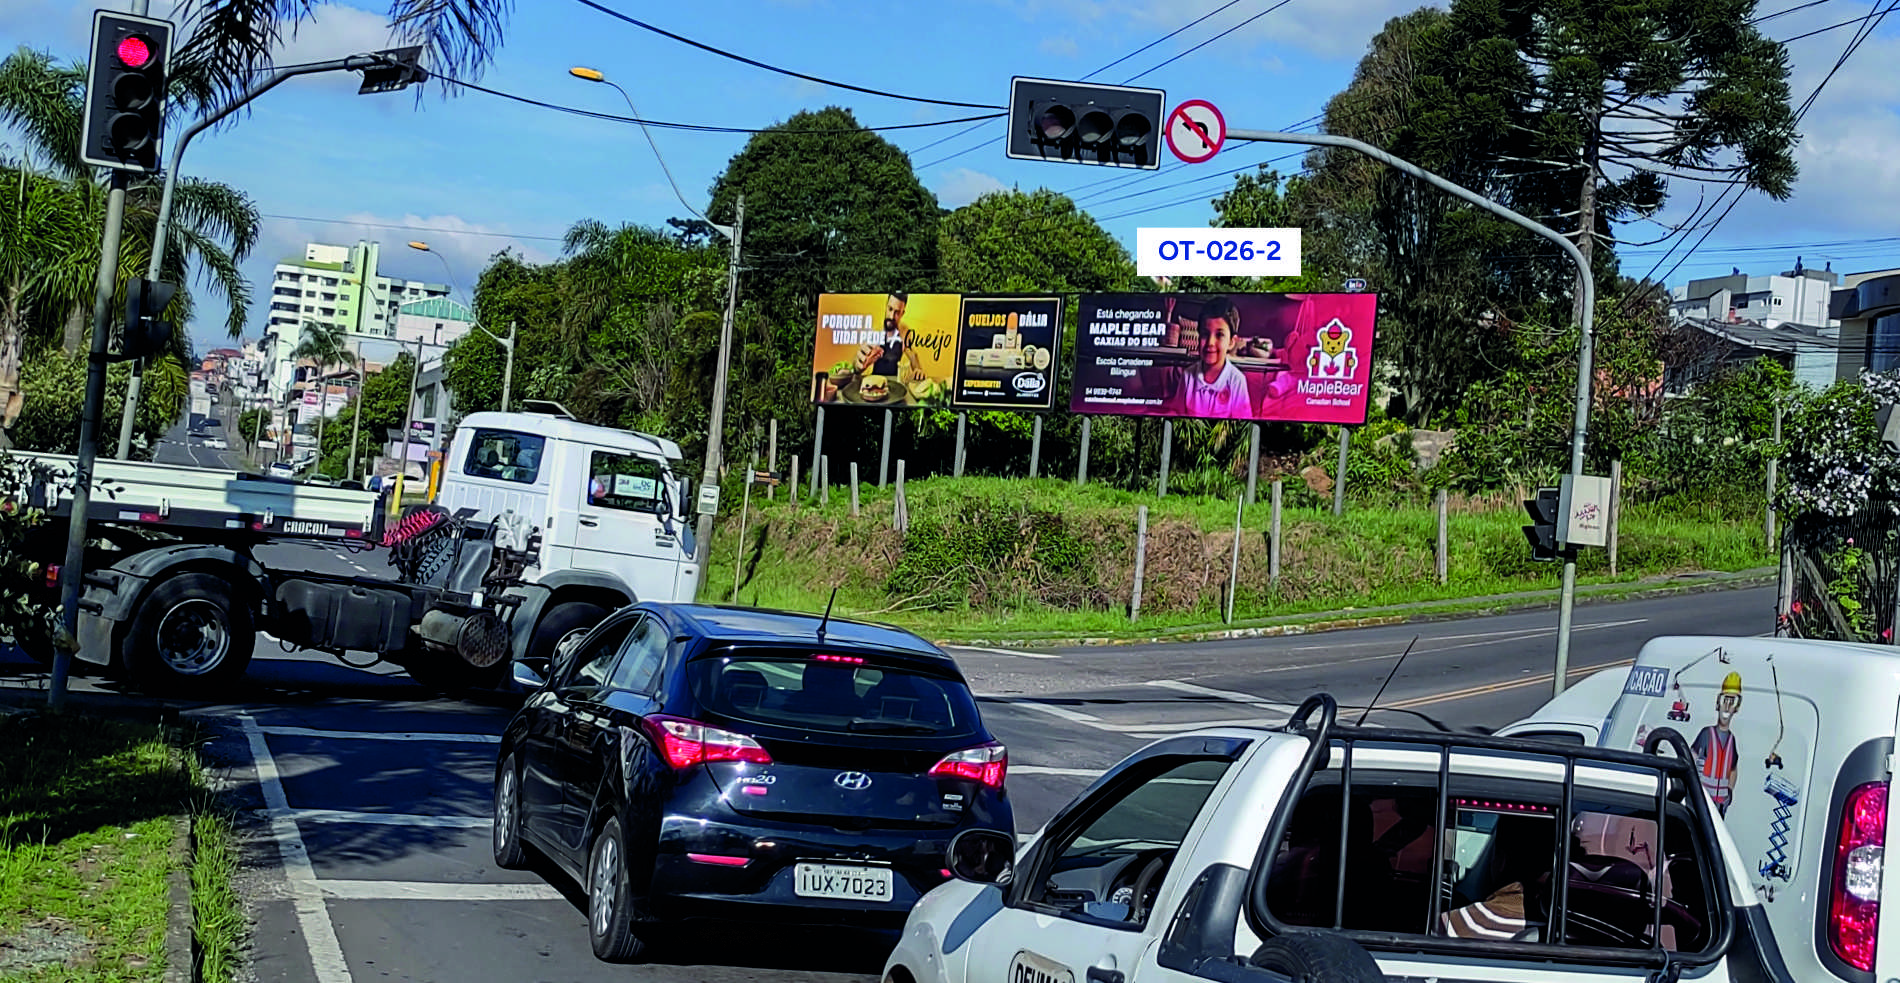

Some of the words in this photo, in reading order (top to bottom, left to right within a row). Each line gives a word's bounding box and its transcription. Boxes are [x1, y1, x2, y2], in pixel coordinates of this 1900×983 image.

[821, 314, 863, 330] PORQUE
[864, 315, 873, 329] A
[968, 314, 1007, 328] QUEIJOS
[1018, 310, 1048, 328] DÁLIA
[1096, 308, 1114, 319] Está
[1115, 309, 1155, 321] chegando
[1155, 311, 1162, 320] a
[1089, 322, 1131, 335] MAPLE
[1132, 323, 1166, 336] BEAR
[832, 330, 858, 345] VIDA
[859, 331, 886, 346] PEDE
[904, 328, 952, 362] Queijo
[1094, 337, 1126, 347] CAXIAS
[1127, 337, 1141, 347] DO
[1141, 337, 1160, 347] SUL
[1297, 379, 1364, 397] MapleBear
